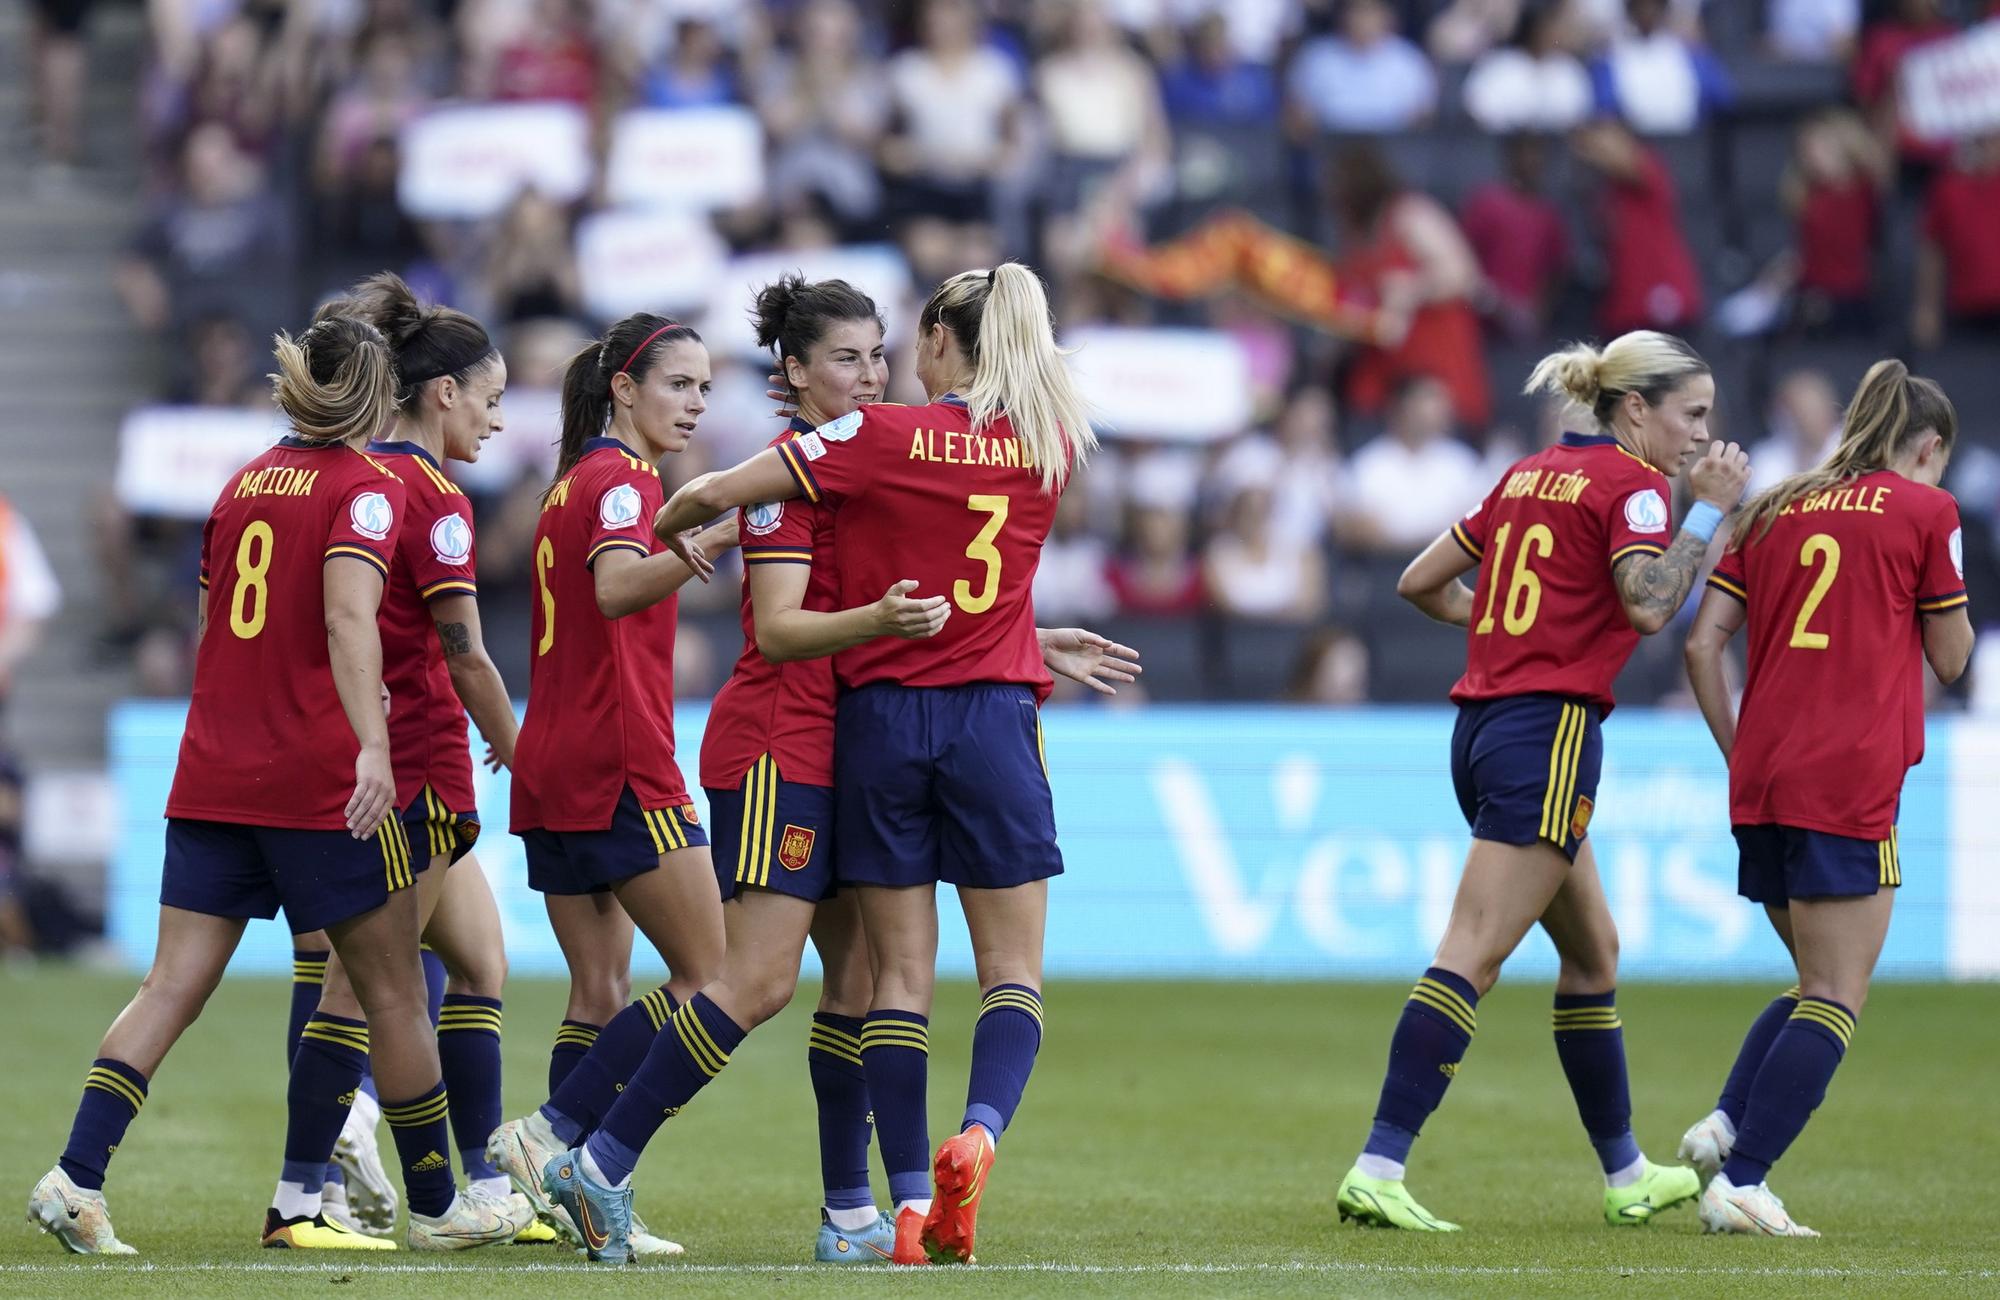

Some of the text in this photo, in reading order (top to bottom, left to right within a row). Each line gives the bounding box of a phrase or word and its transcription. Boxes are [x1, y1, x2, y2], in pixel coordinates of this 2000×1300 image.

[234, 467, 319, 498] MARIONA
[1537, 468, 1591, 505] LEÓN
[1801, 486, 1892, 515] BATLLE
[229, 520, 274, 640] 8
[953, 494, 1010, 614] 3
[1475, 521, 1554, 636] 16
[1789, 533, 1841, 650] 2
[411, 1158, 449, 1172] adidas
